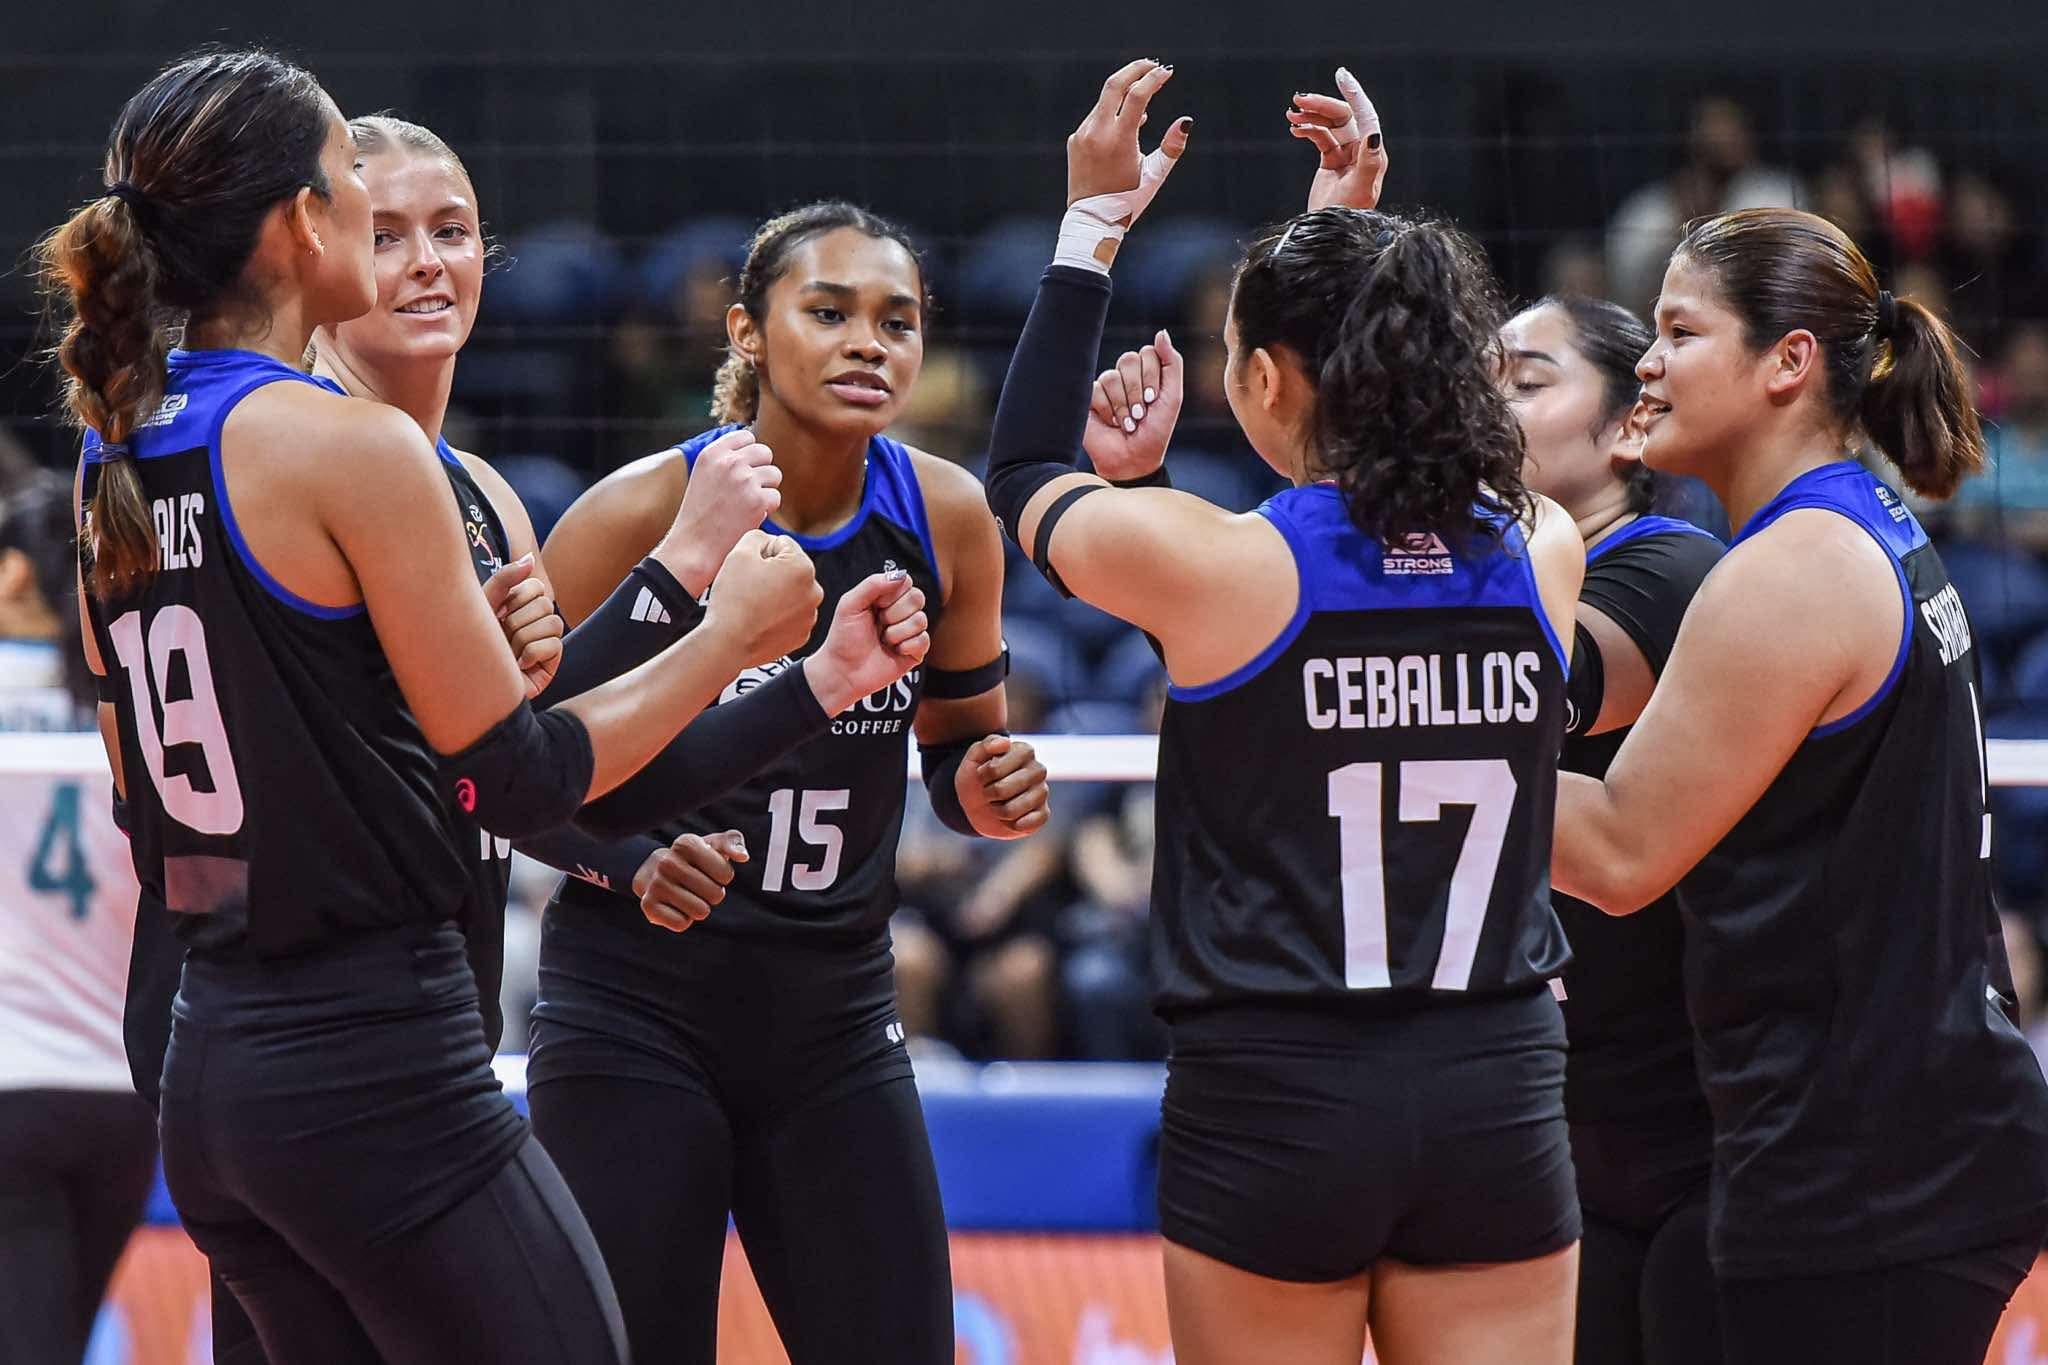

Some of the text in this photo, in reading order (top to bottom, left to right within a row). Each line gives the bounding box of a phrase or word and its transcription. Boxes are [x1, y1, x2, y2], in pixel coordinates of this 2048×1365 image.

[1383, 557, 1452, 569] STRONG
[109, 604, 244, 835] 19
[831, 720, 902, 735] COFFEE
[1303, 651, 1541, 729] CEBALLOS
[28, 780, 96, 920] 4
[762, 788, 850, 892] 15
[1327, 758, 1518, 991] 17
